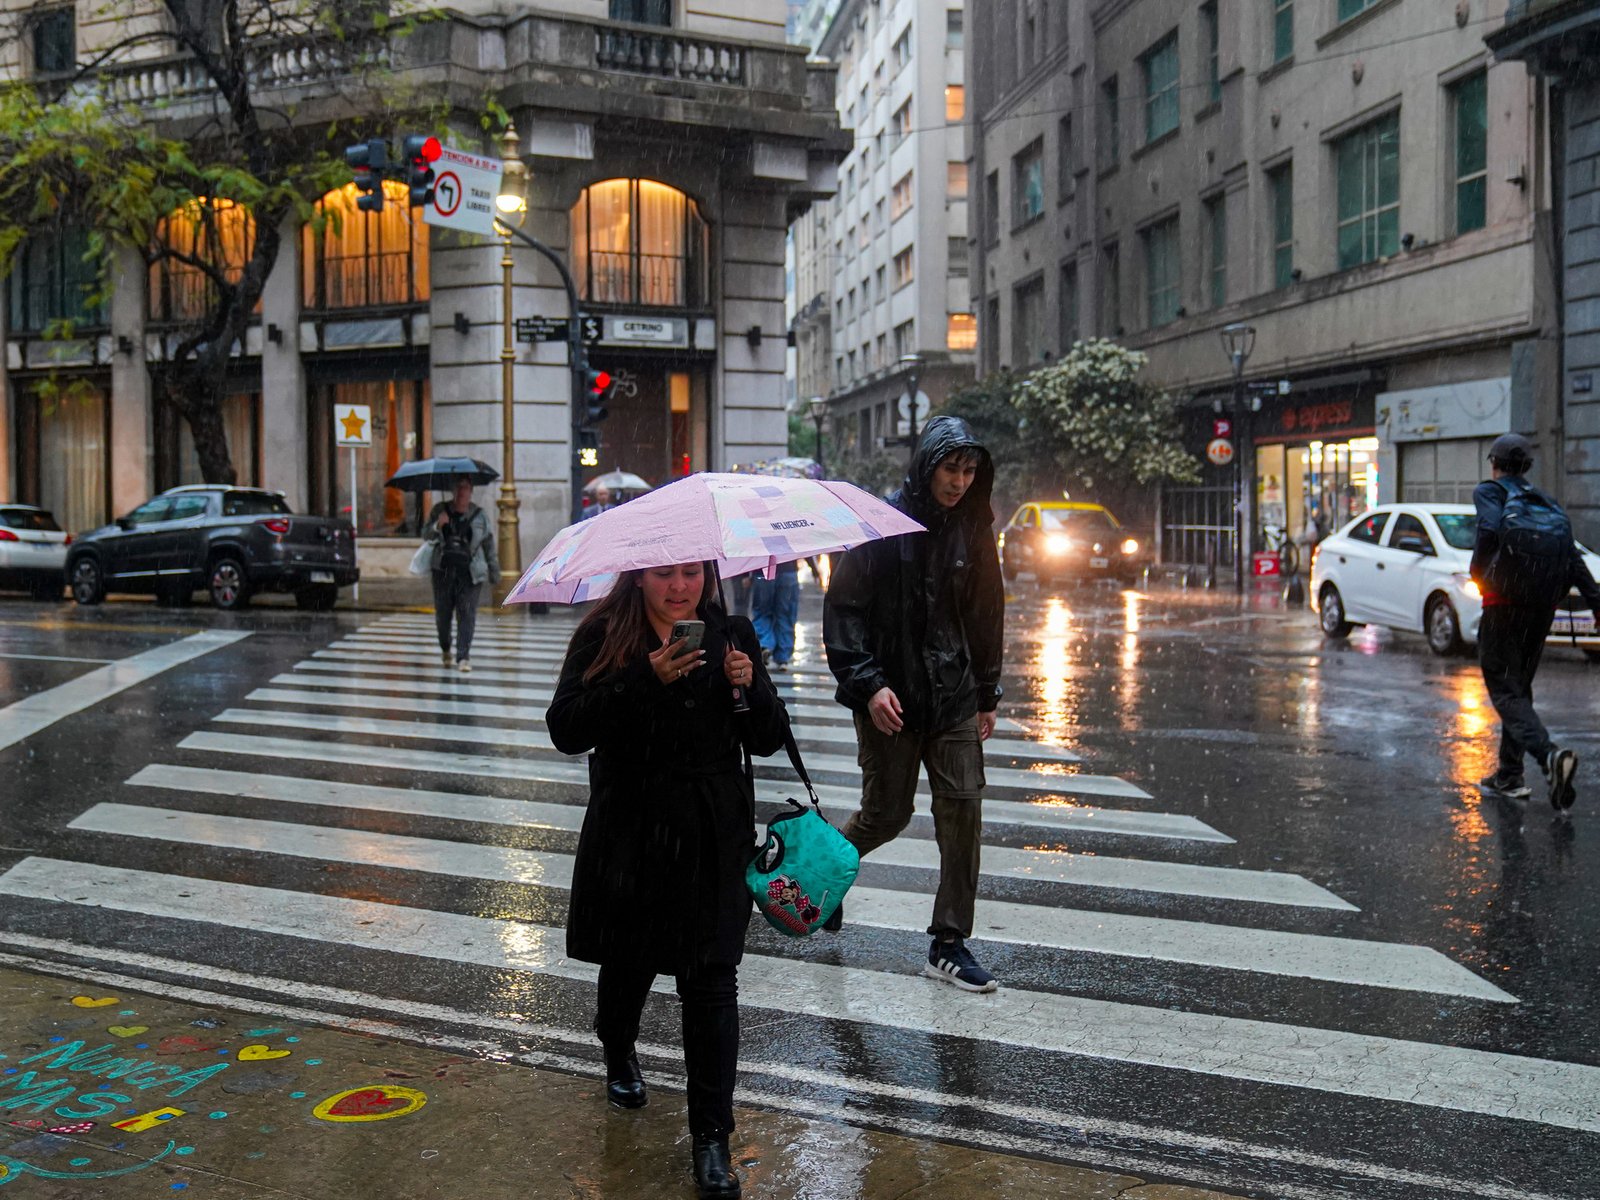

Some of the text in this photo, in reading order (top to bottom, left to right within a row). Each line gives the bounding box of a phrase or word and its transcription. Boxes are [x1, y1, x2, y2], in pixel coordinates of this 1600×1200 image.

[442, 150, 474, 164] TENCION
[624, 322, 663, 332] CETRINO
[770, 519, 809, 531] INFLUENCER
